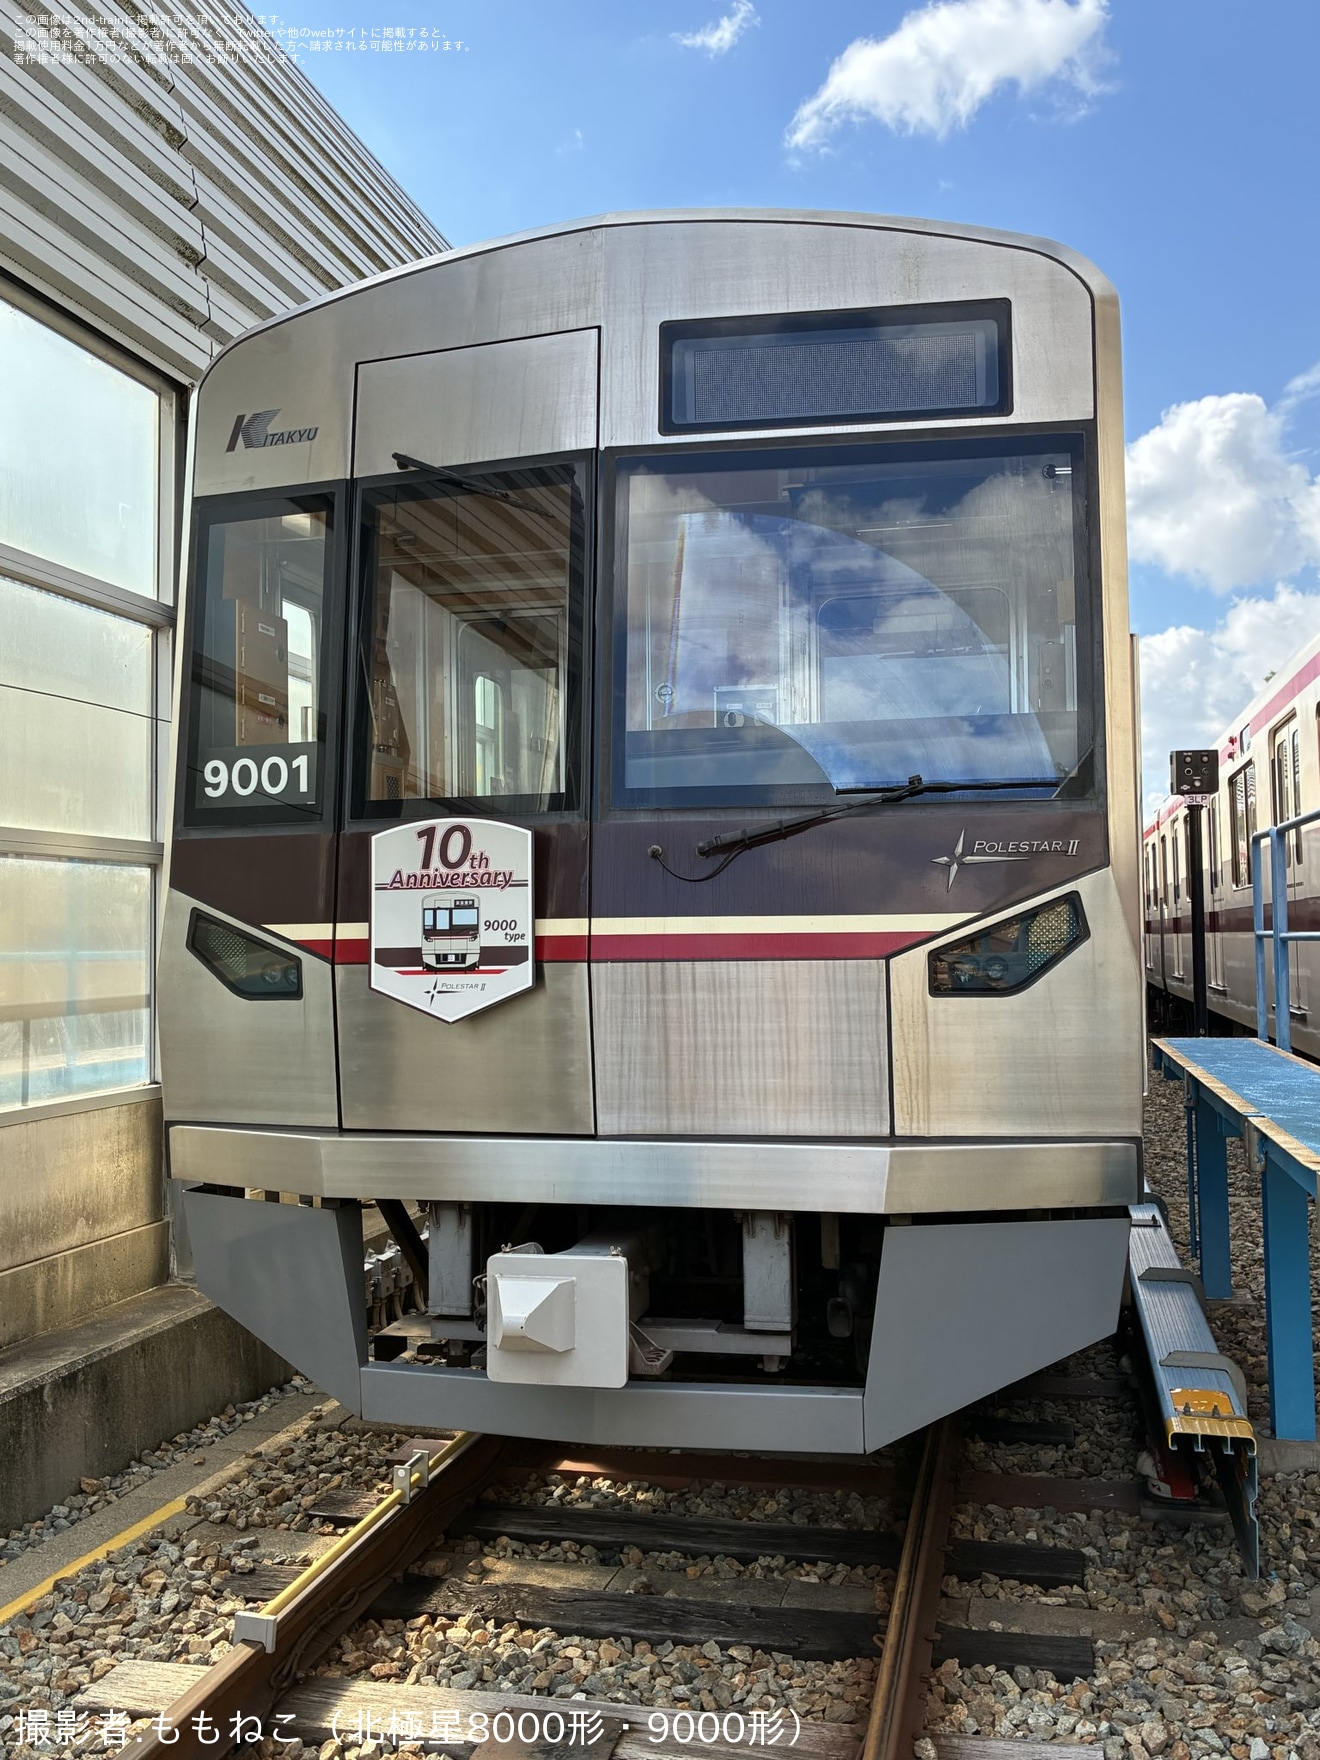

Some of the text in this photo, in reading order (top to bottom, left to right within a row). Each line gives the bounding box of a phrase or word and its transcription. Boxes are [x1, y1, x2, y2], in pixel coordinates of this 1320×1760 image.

[225, 408, 319, 453] KITAKYU
[203, 755, 309, 798] 9001
[415, 823, 489, 870] 10th
[973, 840, 1062, 854] POLESTAR
[388, 867, 513, 892] Anniversary
[483, 919, 517, 931] 9000
[504, 932, 526, 943] type
[441, 982, 479, 991] POLESTAR
